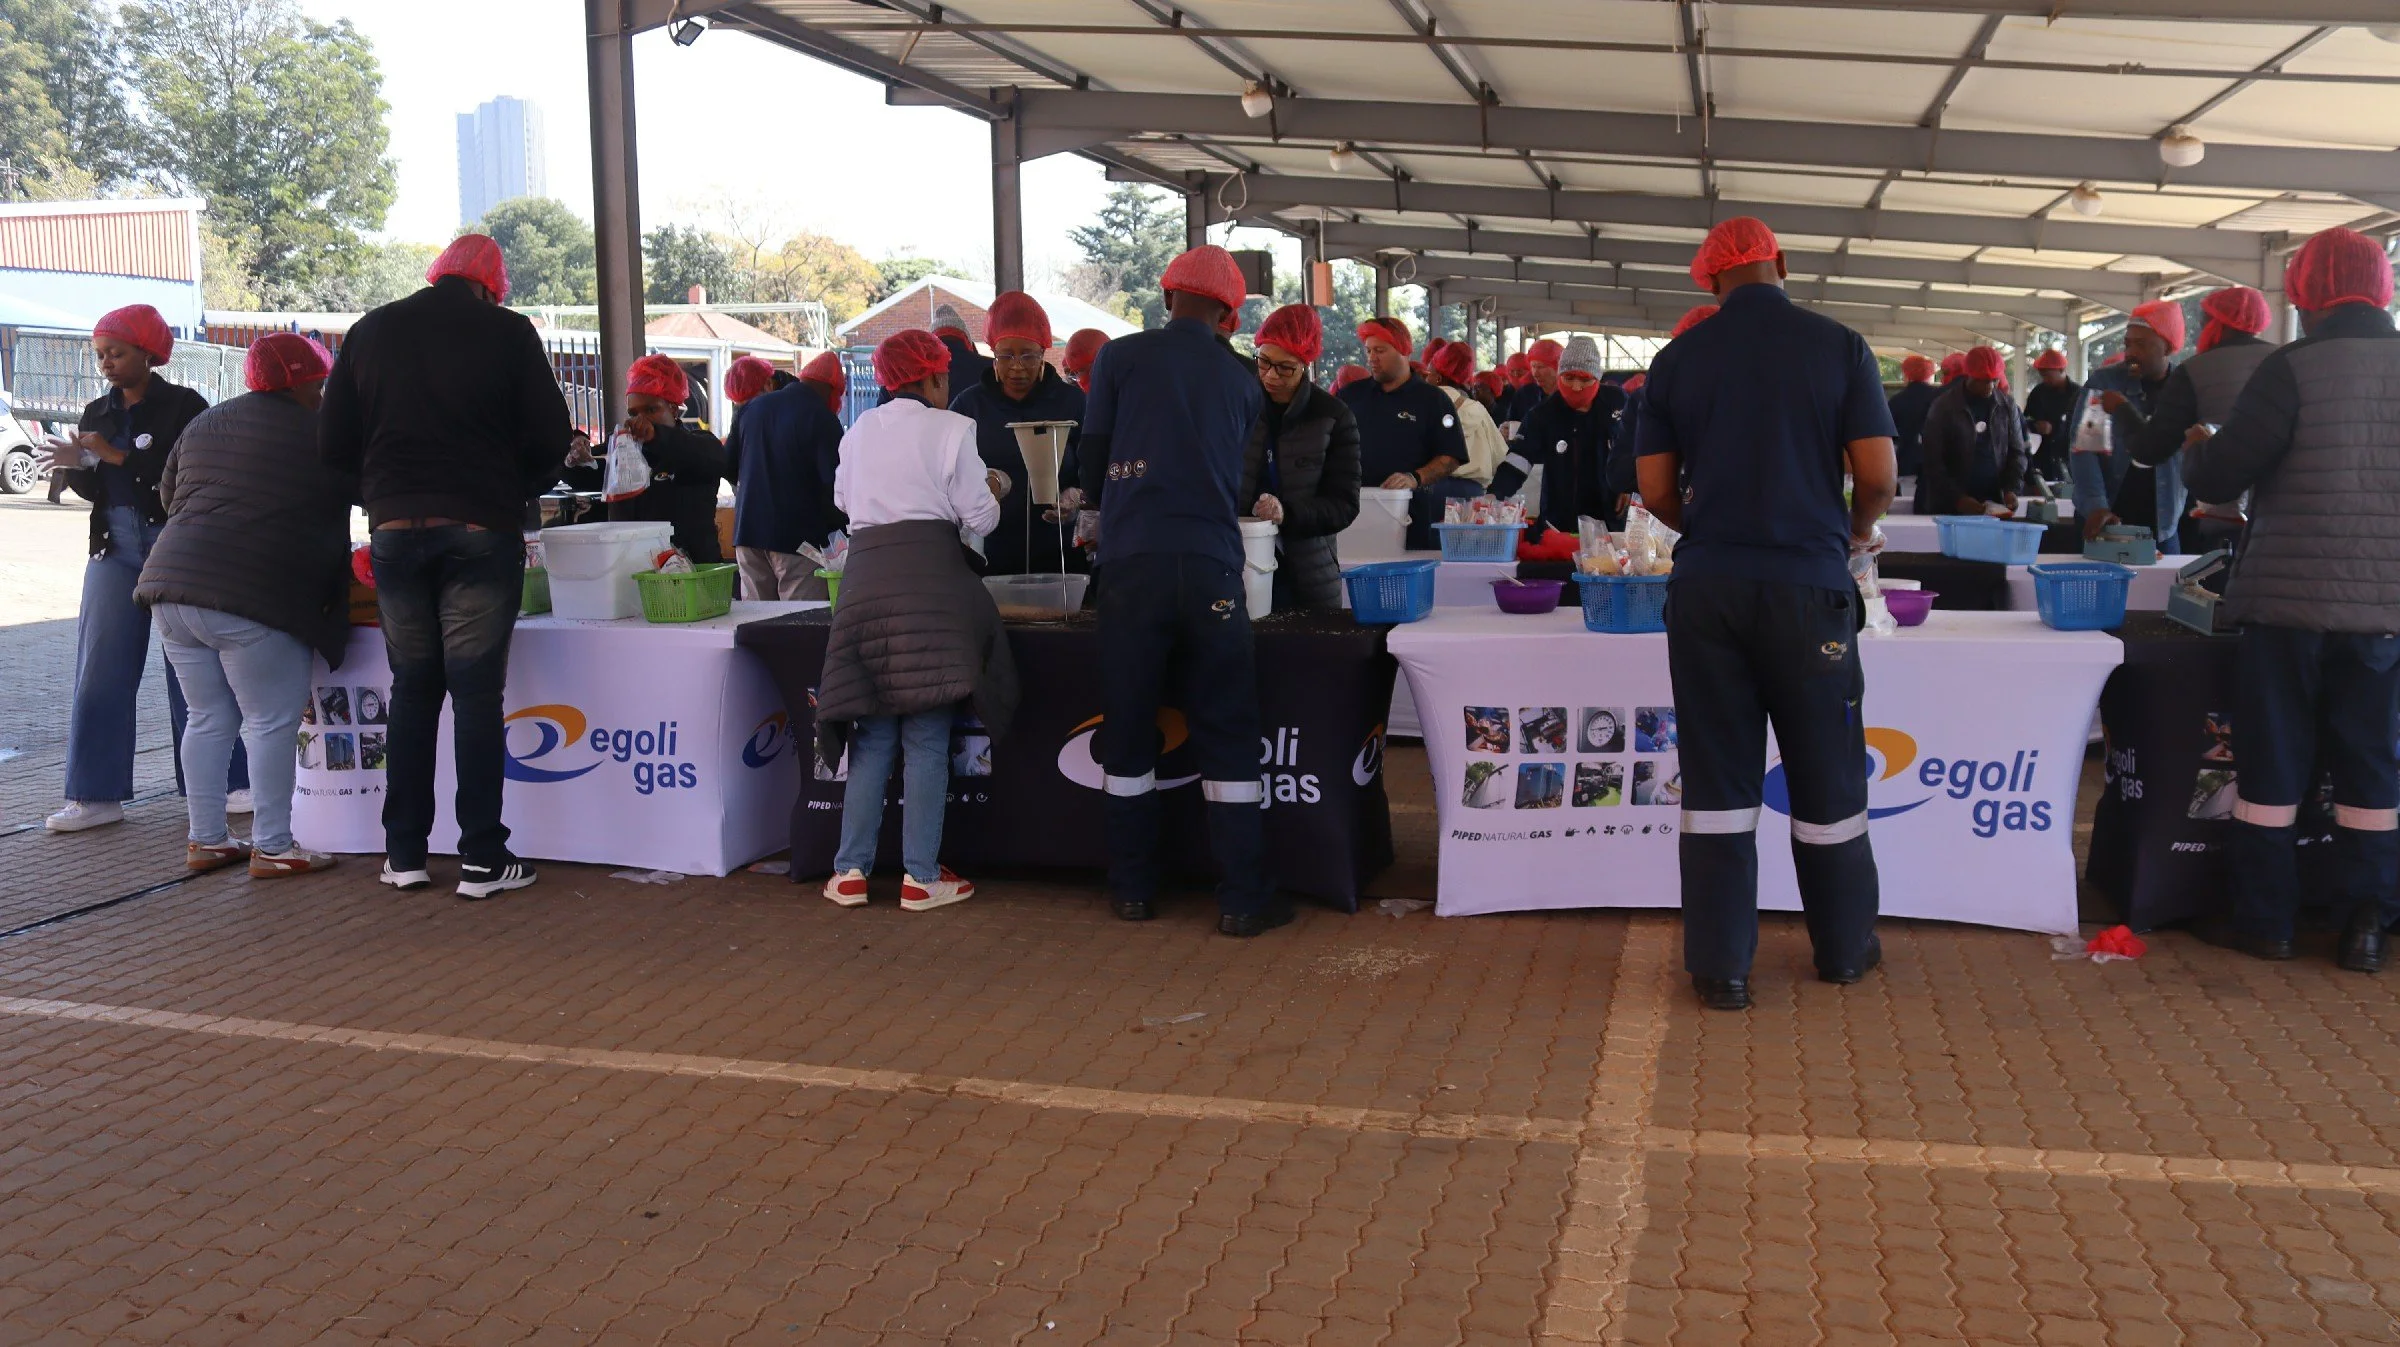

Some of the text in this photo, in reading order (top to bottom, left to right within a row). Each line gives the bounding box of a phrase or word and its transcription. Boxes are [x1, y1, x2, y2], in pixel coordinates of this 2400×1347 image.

[590, 721, 678, 762] egoli
[633, 761, 698, 795] gas
[1919, 750, 2039, 799] egoli
[339, 788, 353, 796] GAS
[2121, 776, 2143, 801] gas
[807, 800, 831, 810] PIPED
[1972, 799, 2052, 838] gas
[1451, 829, 1553, 842] PIPED NATURAL GAS
[2171, 842, 2206, 852] PIPED
